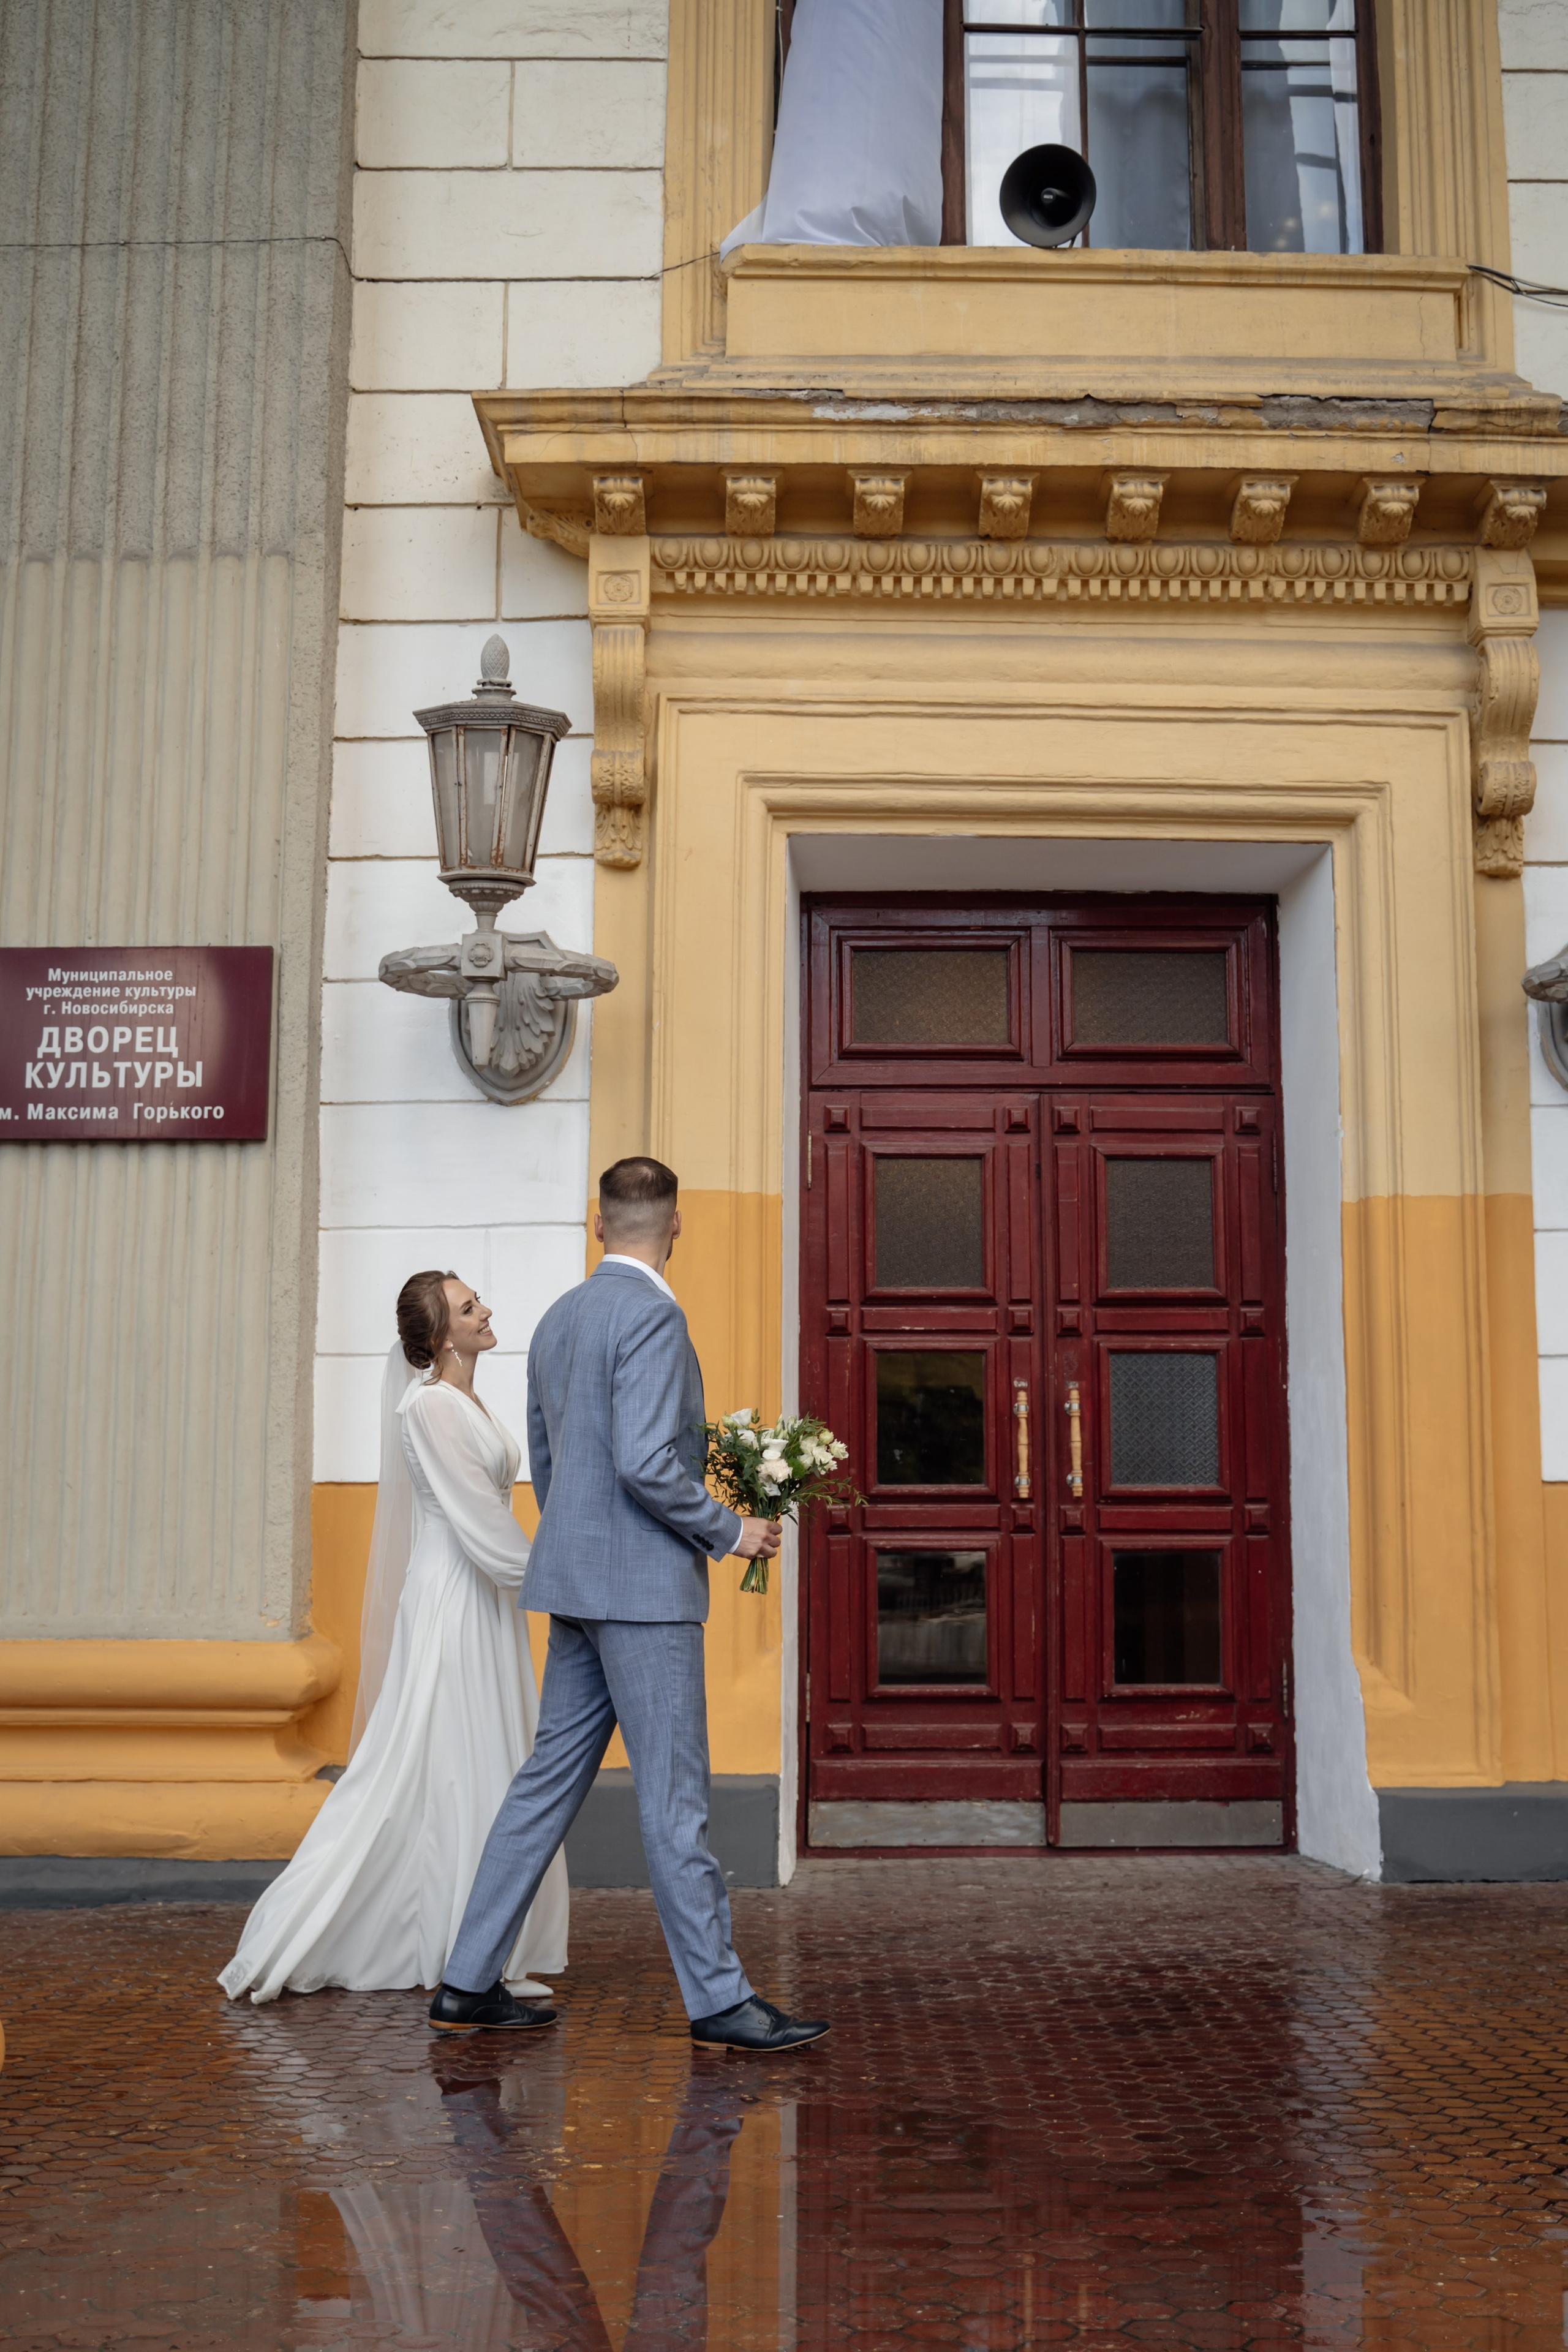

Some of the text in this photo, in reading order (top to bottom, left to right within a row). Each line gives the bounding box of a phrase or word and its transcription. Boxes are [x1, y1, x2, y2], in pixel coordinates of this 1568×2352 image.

[48, 968, 173, 984] Муниципальное
[26, 986, 196, 1000] учреждение культуры
[43, 1000, 174, 1016] г. Новосибирска
[37, 1026, 179, 1058] ДВОРЕЦ
[25, 1061, 203, 1088] КУЛЬТУРЫ
[28, 1103, 119, 1120] Максима
[133, 1102, 224, 1123] Горького
